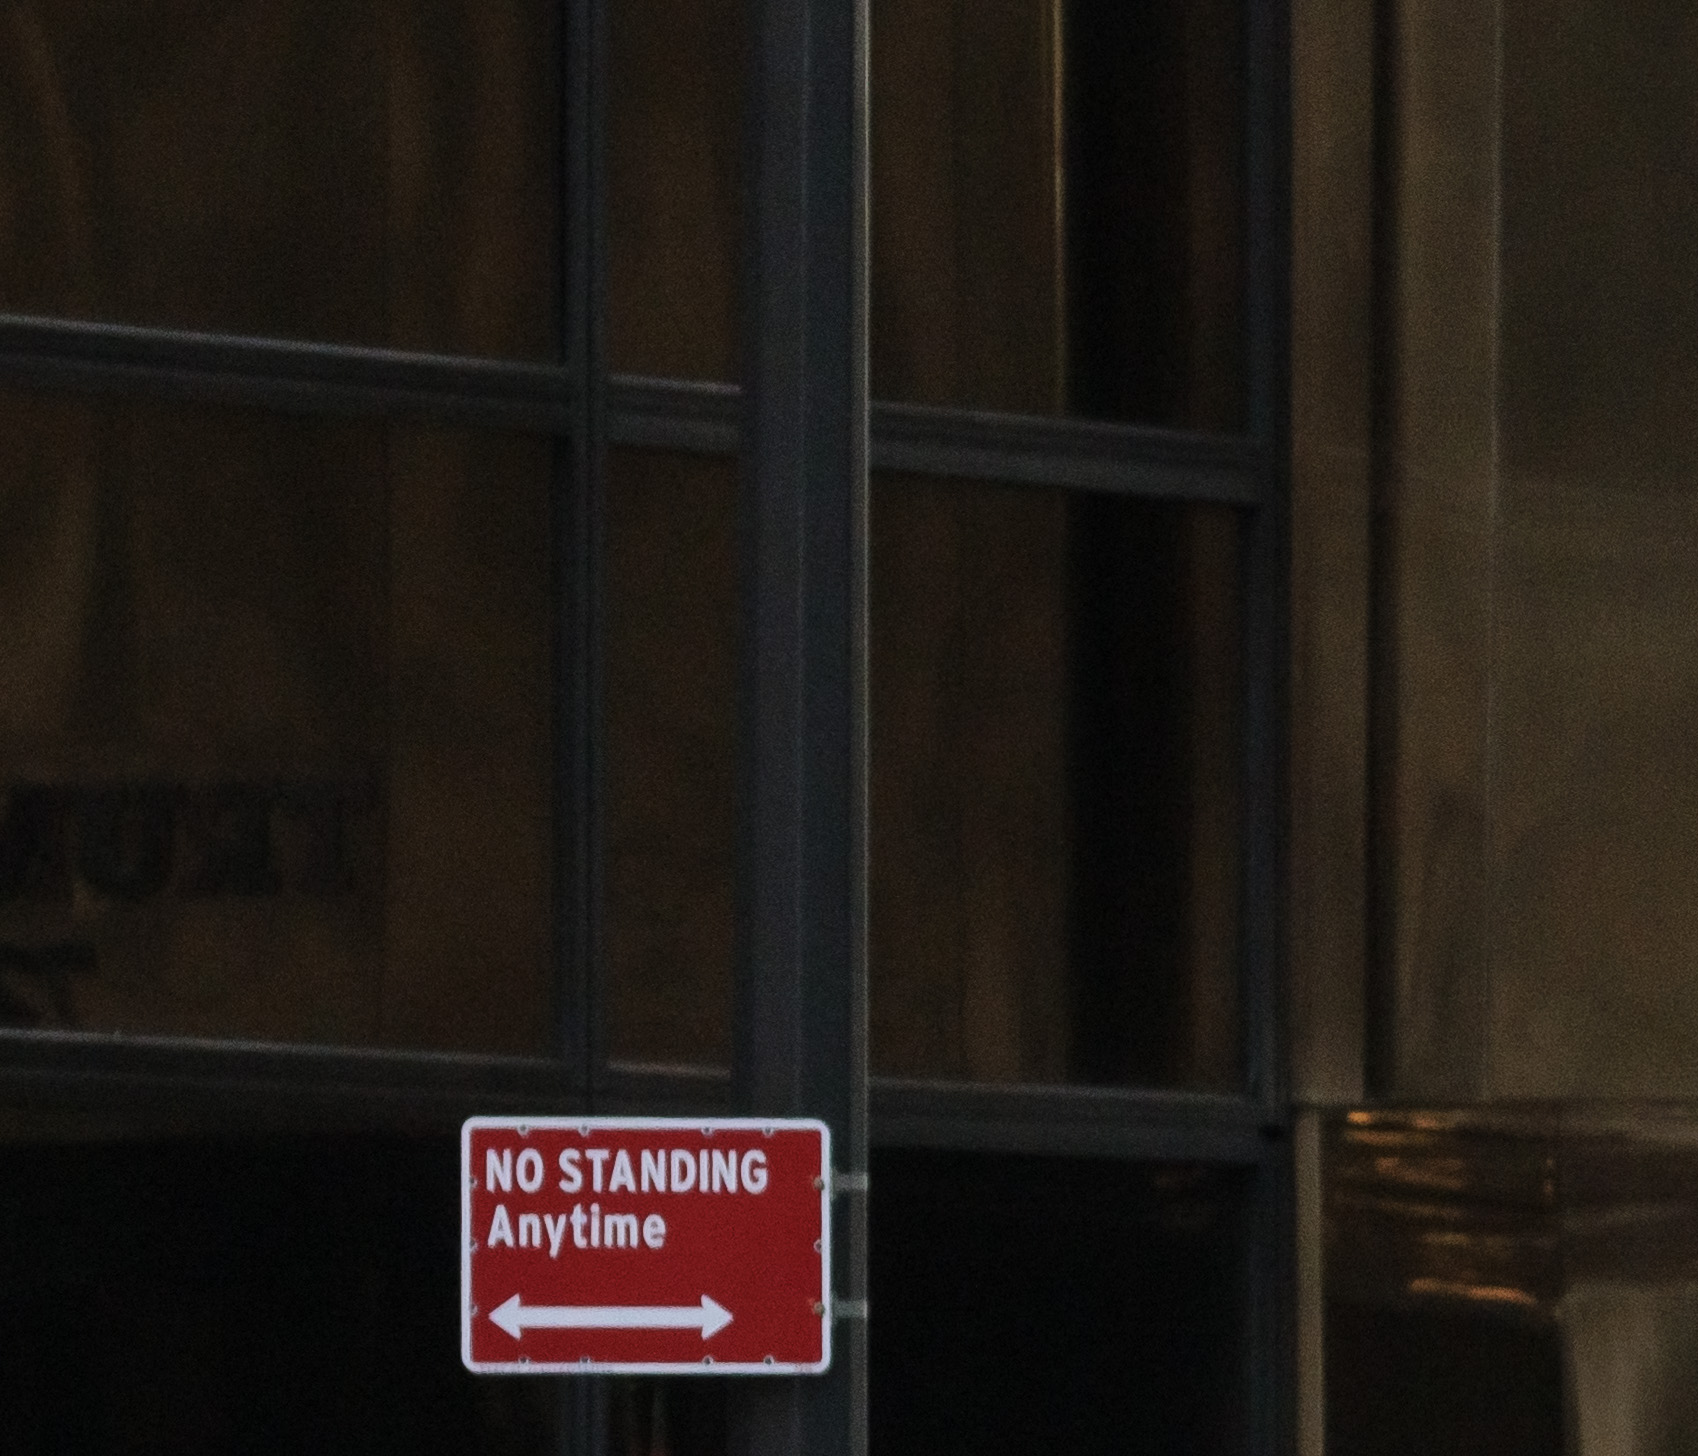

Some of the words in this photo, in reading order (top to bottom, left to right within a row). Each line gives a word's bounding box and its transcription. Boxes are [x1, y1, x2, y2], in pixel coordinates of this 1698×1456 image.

[485, 1147, 544, 1193] NO
[558, 1147, 768, 1194] STANDING
[487, 1202, 667, 1259] Anytime
